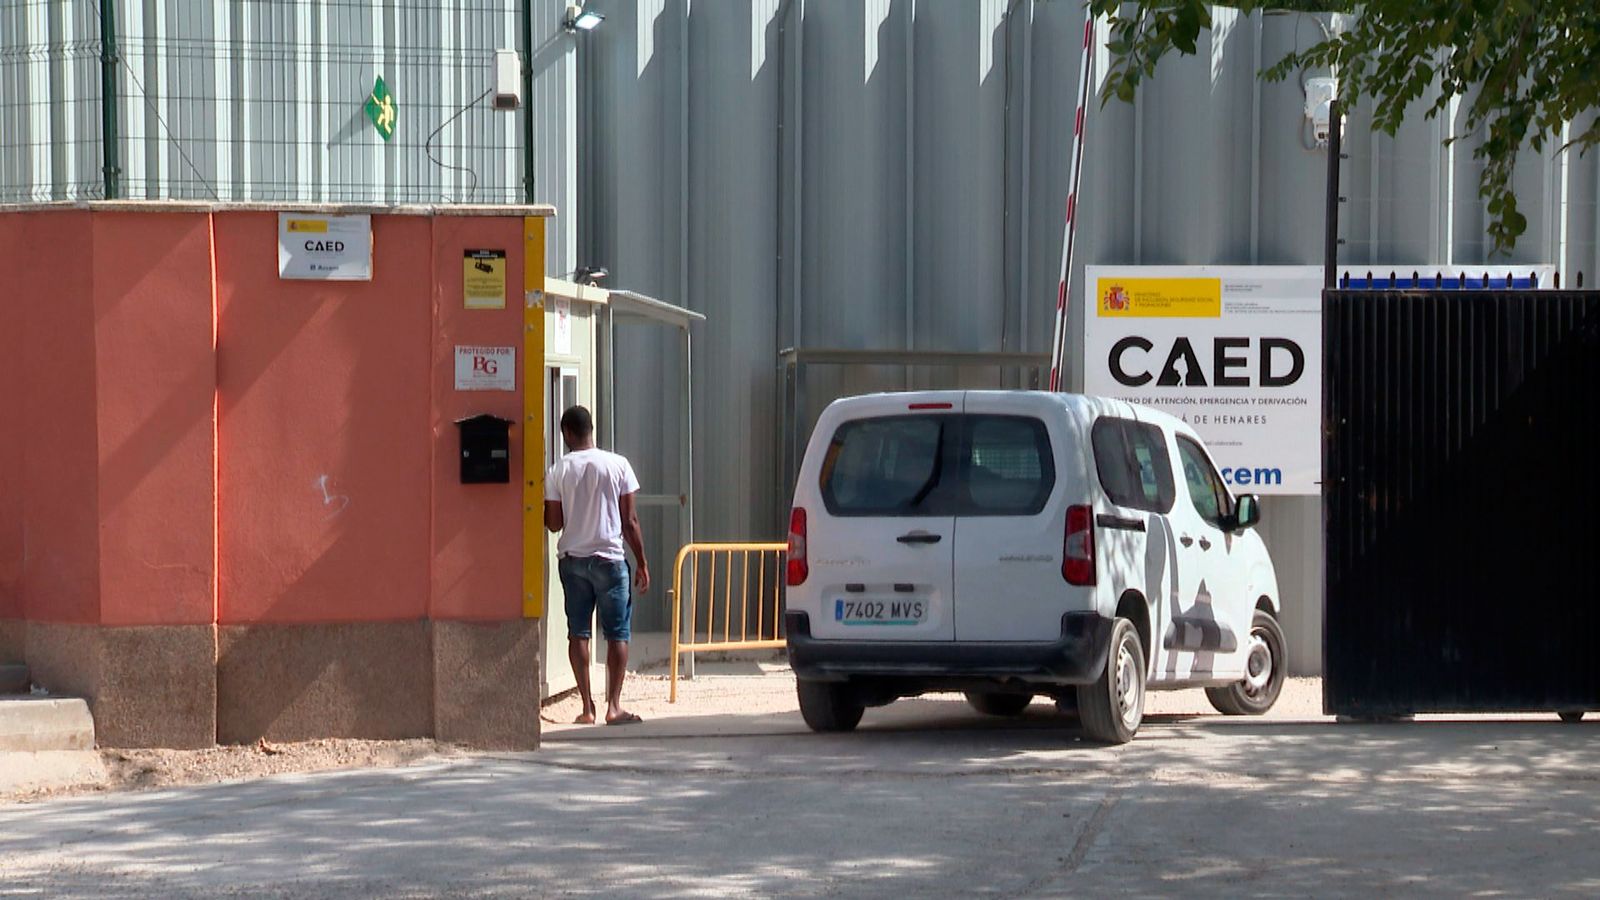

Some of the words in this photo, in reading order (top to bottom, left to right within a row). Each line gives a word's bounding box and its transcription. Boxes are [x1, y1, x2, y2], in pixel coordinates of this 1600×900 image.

[304, 240, 345, 252] CAED
[473, 356, 498, 375] BG
[1108, 335, 1305, 387] CAED
[1141, 397, 1152, 405] DE
[1199, 397, 1249, 405] EMERGENCIA
[1251, 397, 1257, 405] Y
[1258, 396, 1307, 405] DERIVACIÓN
[1194, 415, 1209, 424] DE
[1214, 415, 1268, 424] HENARES
[845, 602, 884, 619] 7402
[891, 602, 923, 619] MVS
